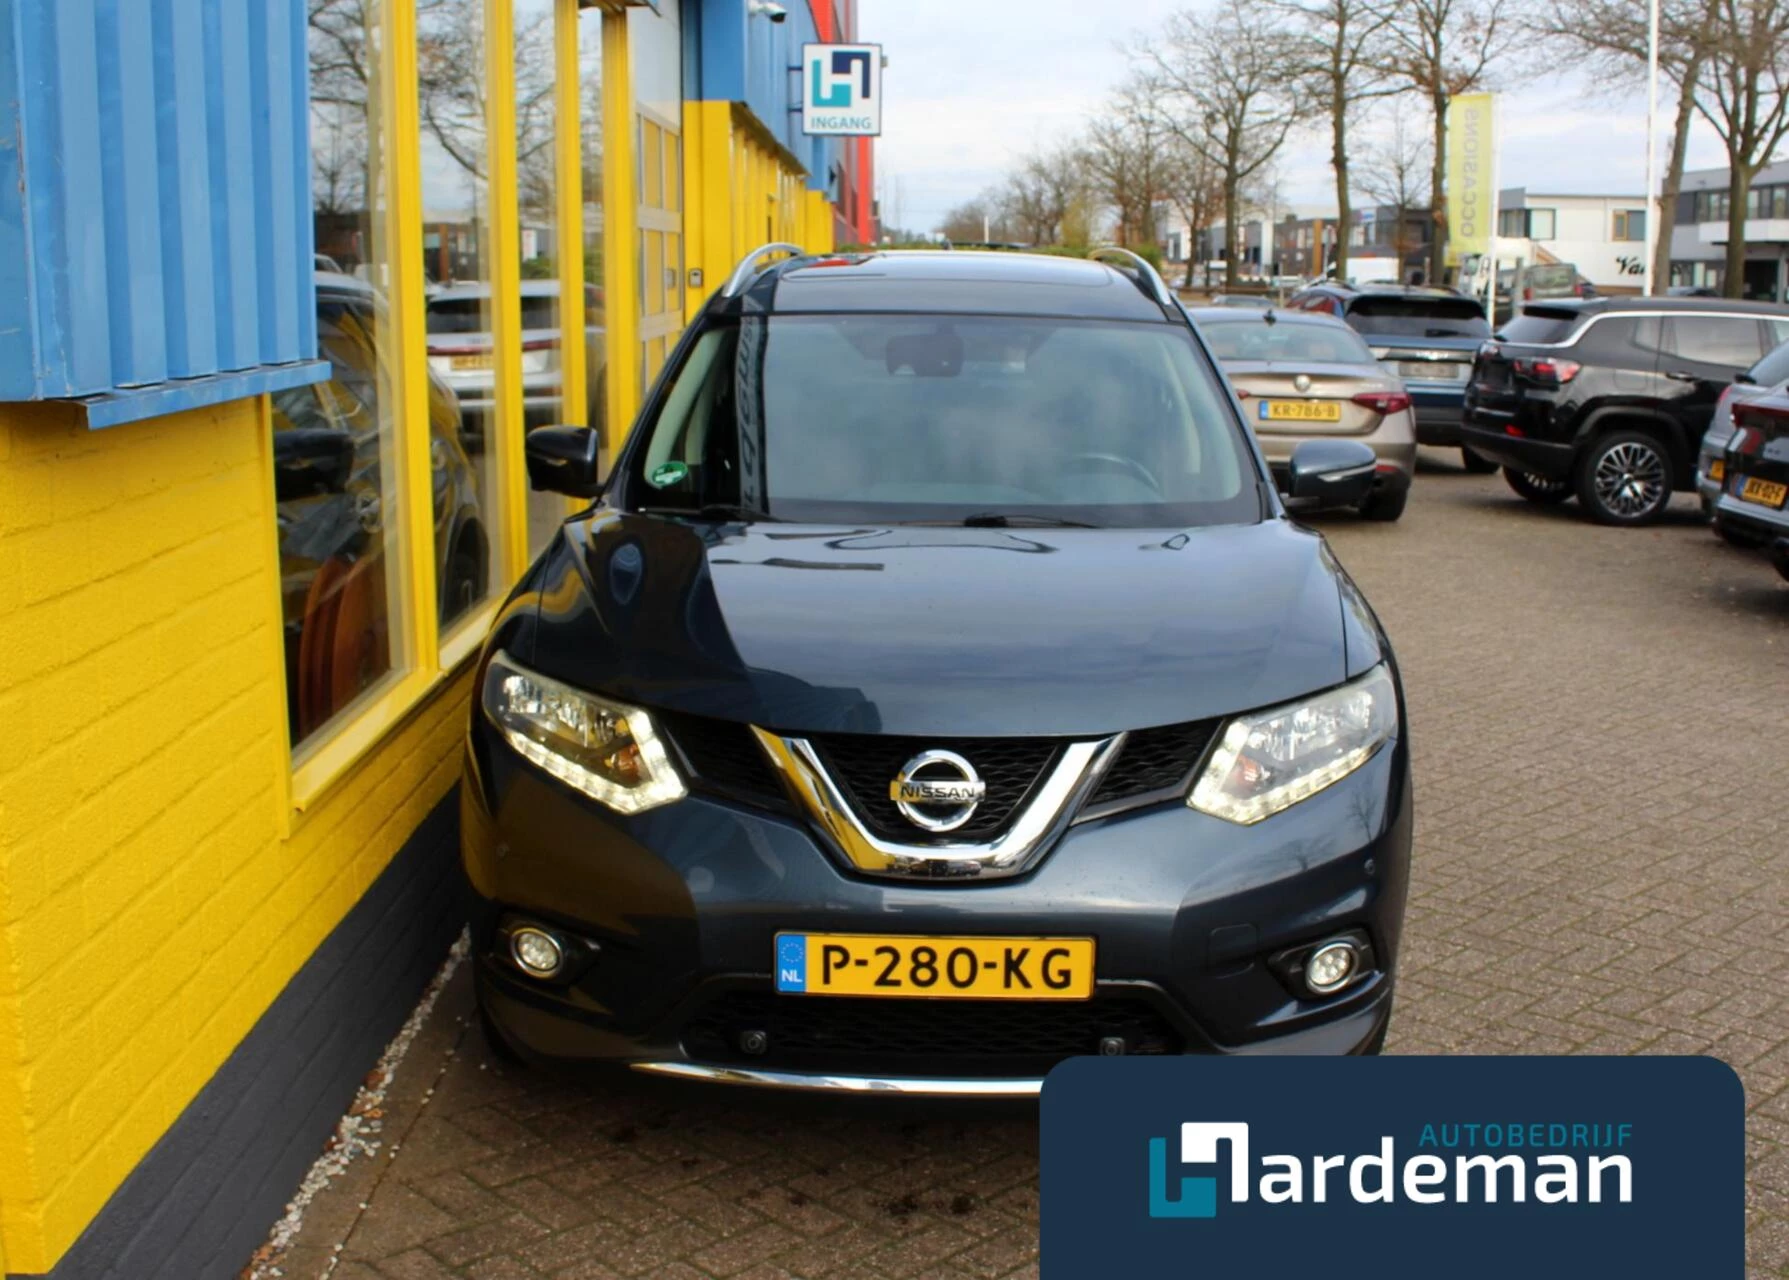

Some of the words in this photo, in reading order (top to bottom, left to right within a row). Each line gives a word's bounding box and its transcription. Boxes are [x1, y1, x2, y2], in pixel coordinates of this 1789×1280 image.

[811, 115, 872, 129] INGANG
[900, 784, 974, 798] NISSAN
[781, 969, 802, 982] NL
[822, 944, 1072, 989] P-280-KG
